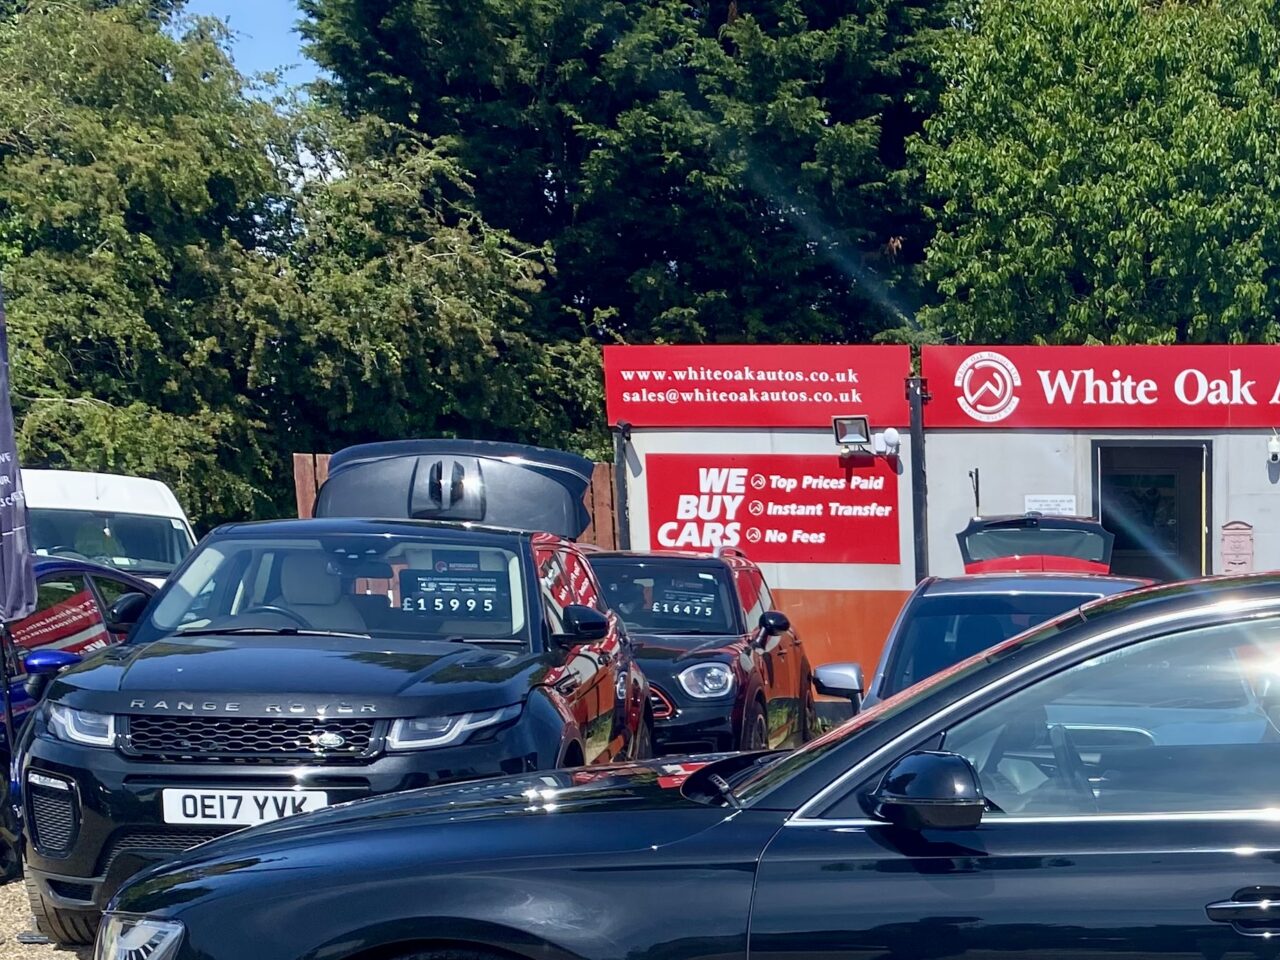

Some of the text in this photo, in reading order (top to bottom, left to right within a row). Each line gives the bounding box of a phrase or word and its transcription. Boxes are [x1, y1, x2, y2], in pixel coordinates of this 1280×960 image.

[620, 366, 859, 383] www.whiteoakautos.co.uk
[1037, 368, 1158, 405] White
[1174, 368, 1257, 406] Oak
[622, 388, 862, 404] sales@whiteoakautos.co.uk
[698, 467, 748, 494] WE
[769, 475, 884, 492] Top Prices Paid
[676, 495, 744, 521] BUY
[767, 502, 892, 517] Instant Transfer
[657, 521, 741, 548] CARS
[764, 529, 826, 543] No Fees
[402, 597, 493, 612] £15995
[652, 602, 712, 616] £16475
[130, 699, 377, 714] RANGE ROVER
[181, 794, 308, 820] OE17 YVK
